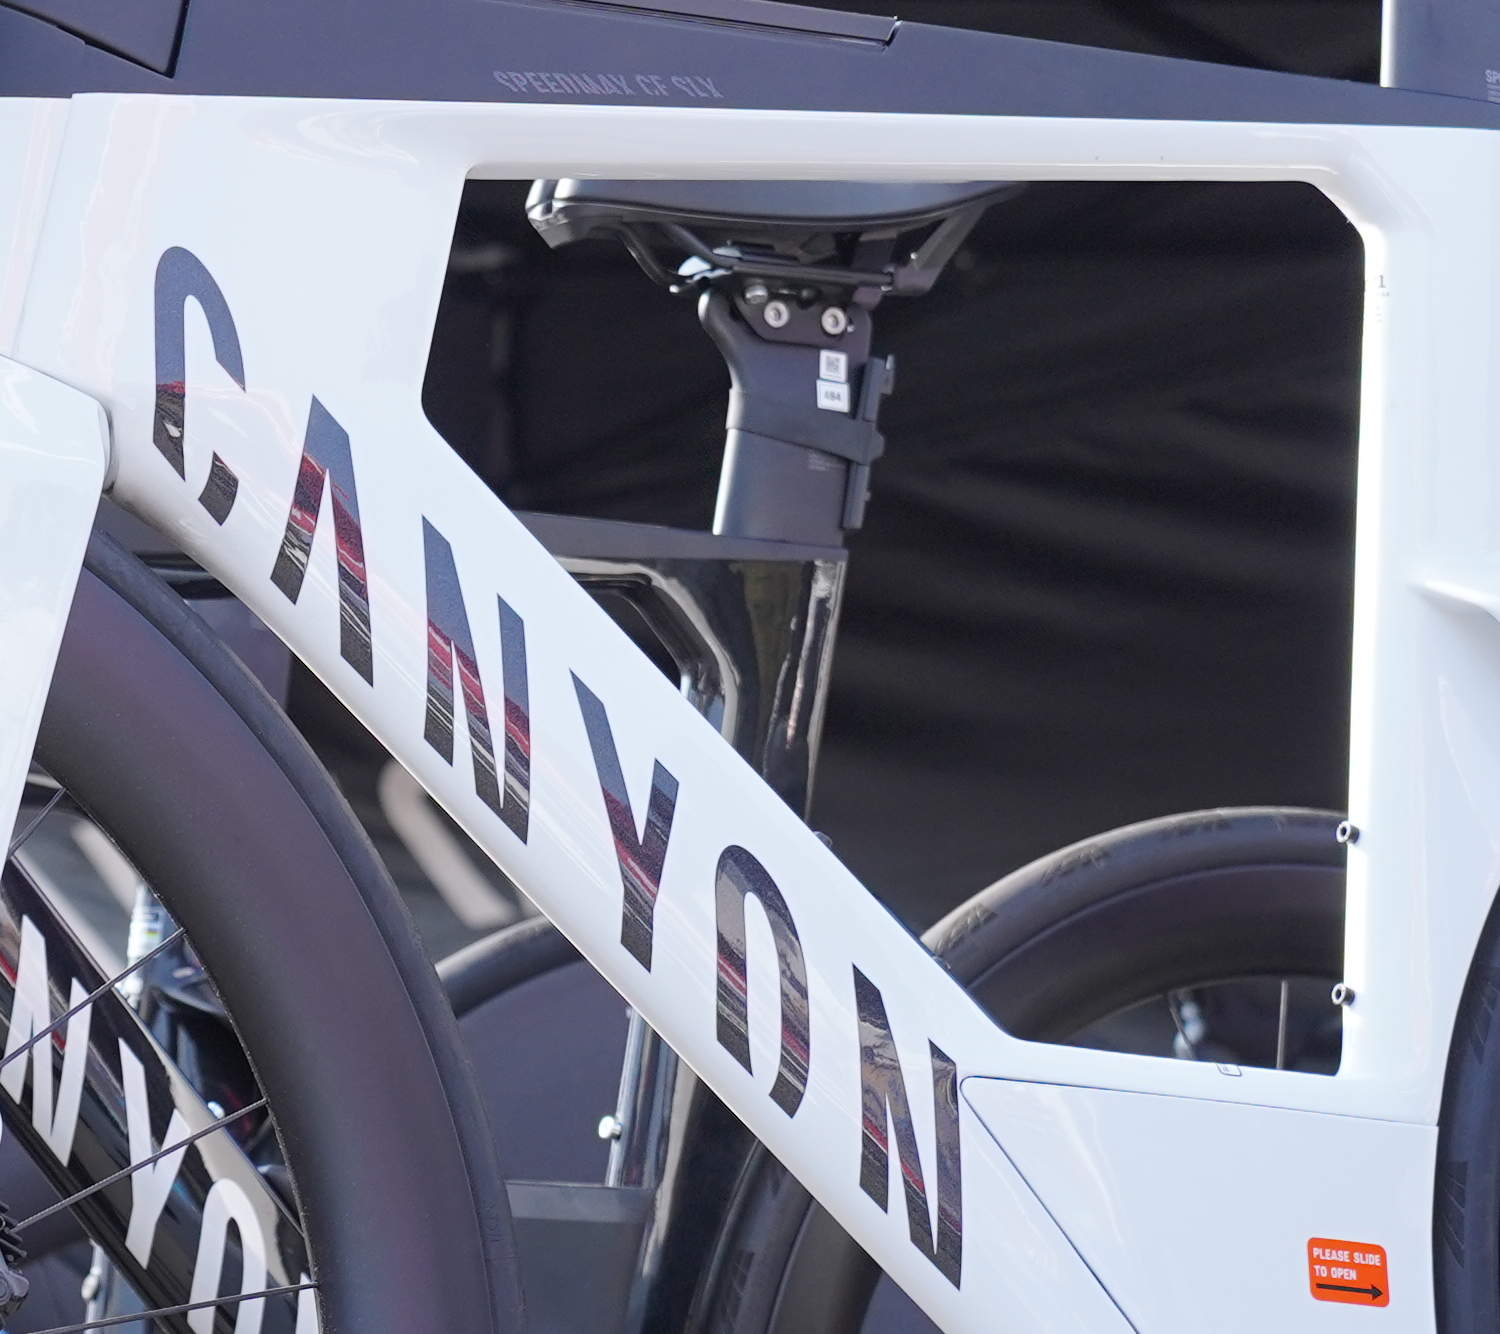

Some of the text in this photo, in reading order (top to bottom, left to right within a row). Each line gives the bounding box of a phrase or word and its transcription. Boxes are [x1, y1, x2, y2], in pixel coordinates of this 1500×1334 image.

[493, 70, 637, 95] SPEEDMAX
[634, 74, 669, 96] CF
[153, 246, 963, 1290] CANYON
[1312, 1247, 1382, 1266] PLEASE SLIDE
[1313, 1265, 1357, 1281] TO OPEN
